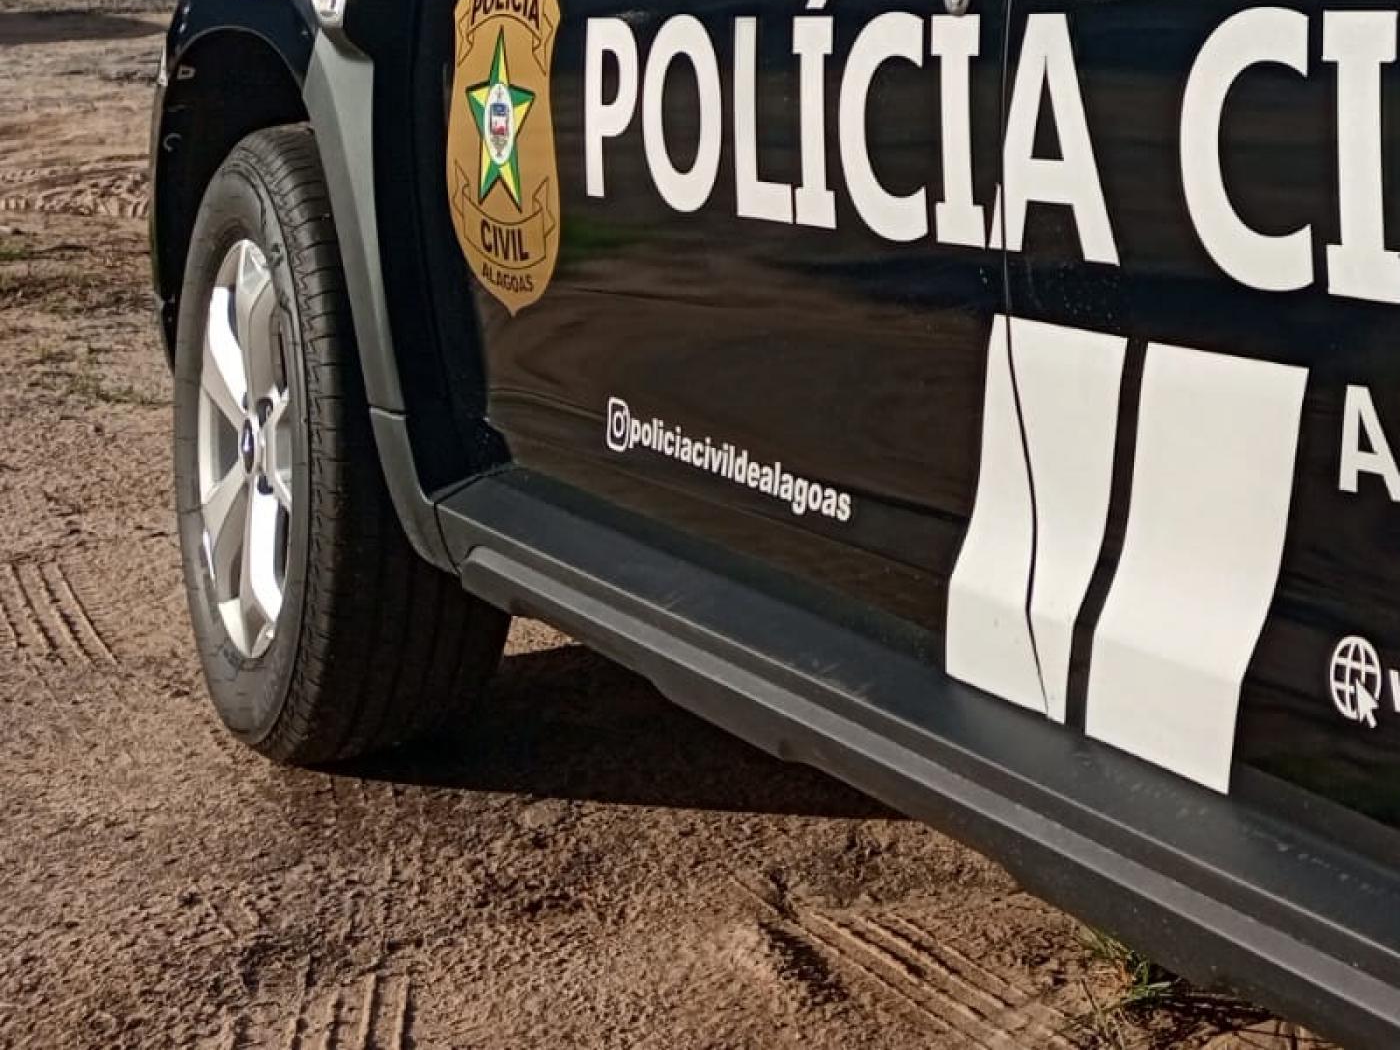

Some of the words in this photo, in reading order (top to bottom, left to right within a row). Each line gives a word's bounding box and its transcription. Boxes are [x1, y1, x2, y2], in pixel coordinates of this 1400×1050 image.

[481, 218, 530, 262] CIVIL
[482, 261, 535, 294] ALAGOAS
[629, 417, 852, 522] policiacivildealagoas
